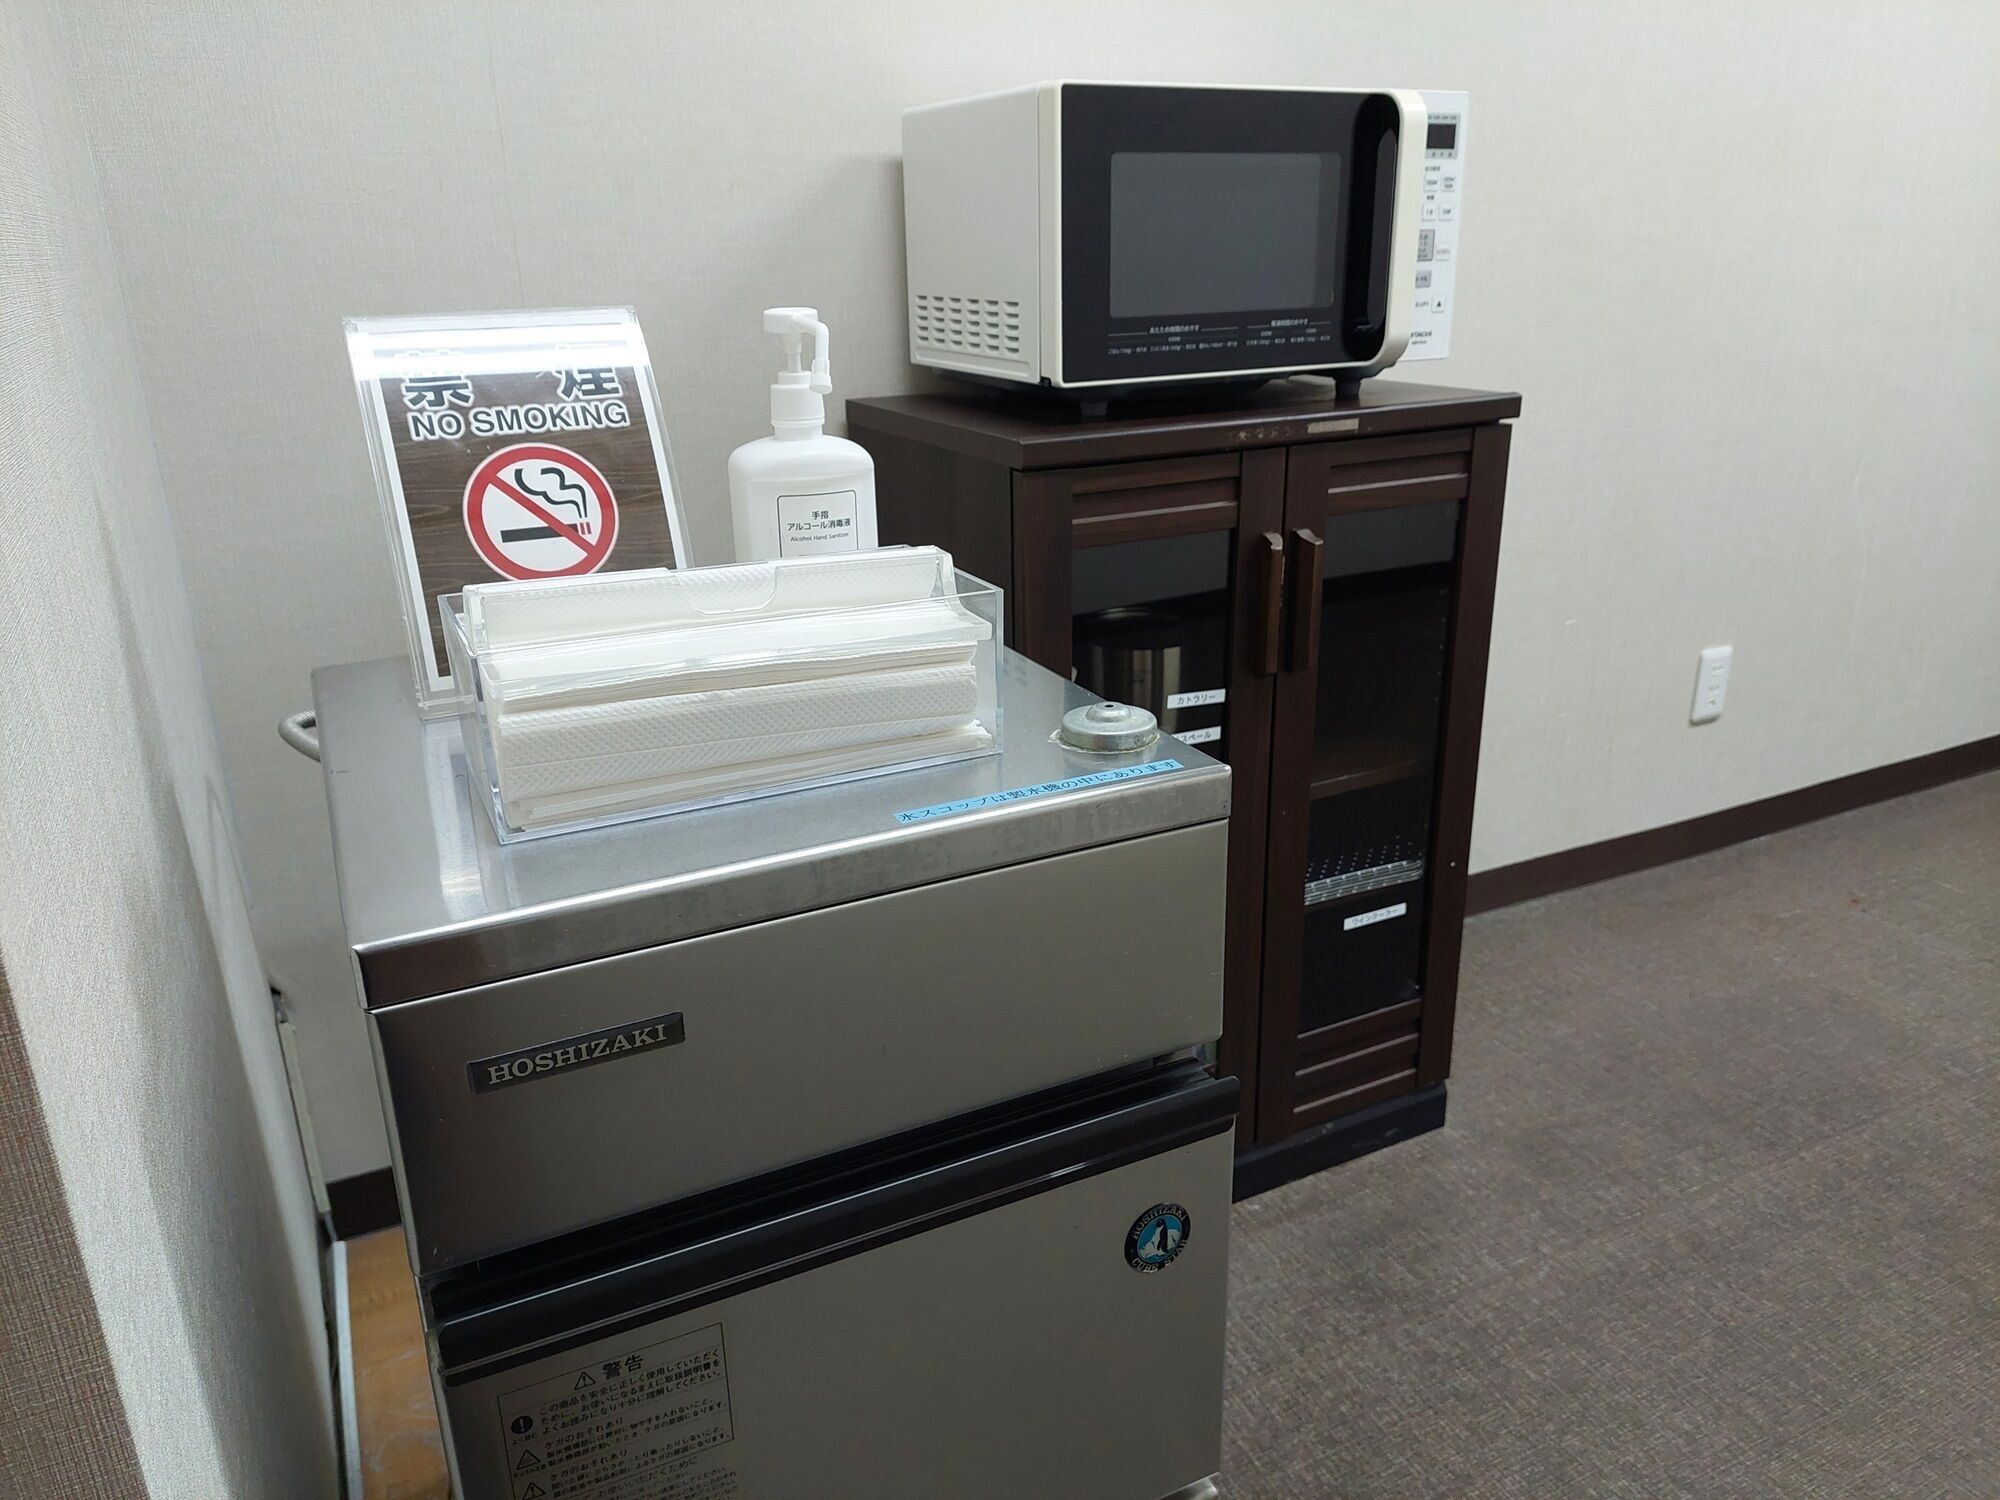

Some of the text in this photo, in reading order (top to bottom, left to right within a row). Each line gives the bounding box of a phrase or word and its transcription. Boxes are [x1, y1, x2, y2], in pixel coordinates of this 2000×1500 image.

[410, 403, 628, 438] NO SMOKING
[811, 510, 829, 520] 手指
[787, 518, 851, 531] アルコール消毒液
[790, 534, 812, 542] Alcohol
[1177, 694, 1215, 705] カトラリー
[1178, 731, 1211, 742] スペール
[487, 1023, 668, 1084] HOSHIZAKI
[1131, 1205, 1187, 1239] HOSHIZAKI
[602, 1354, 643, 1379] 警告
